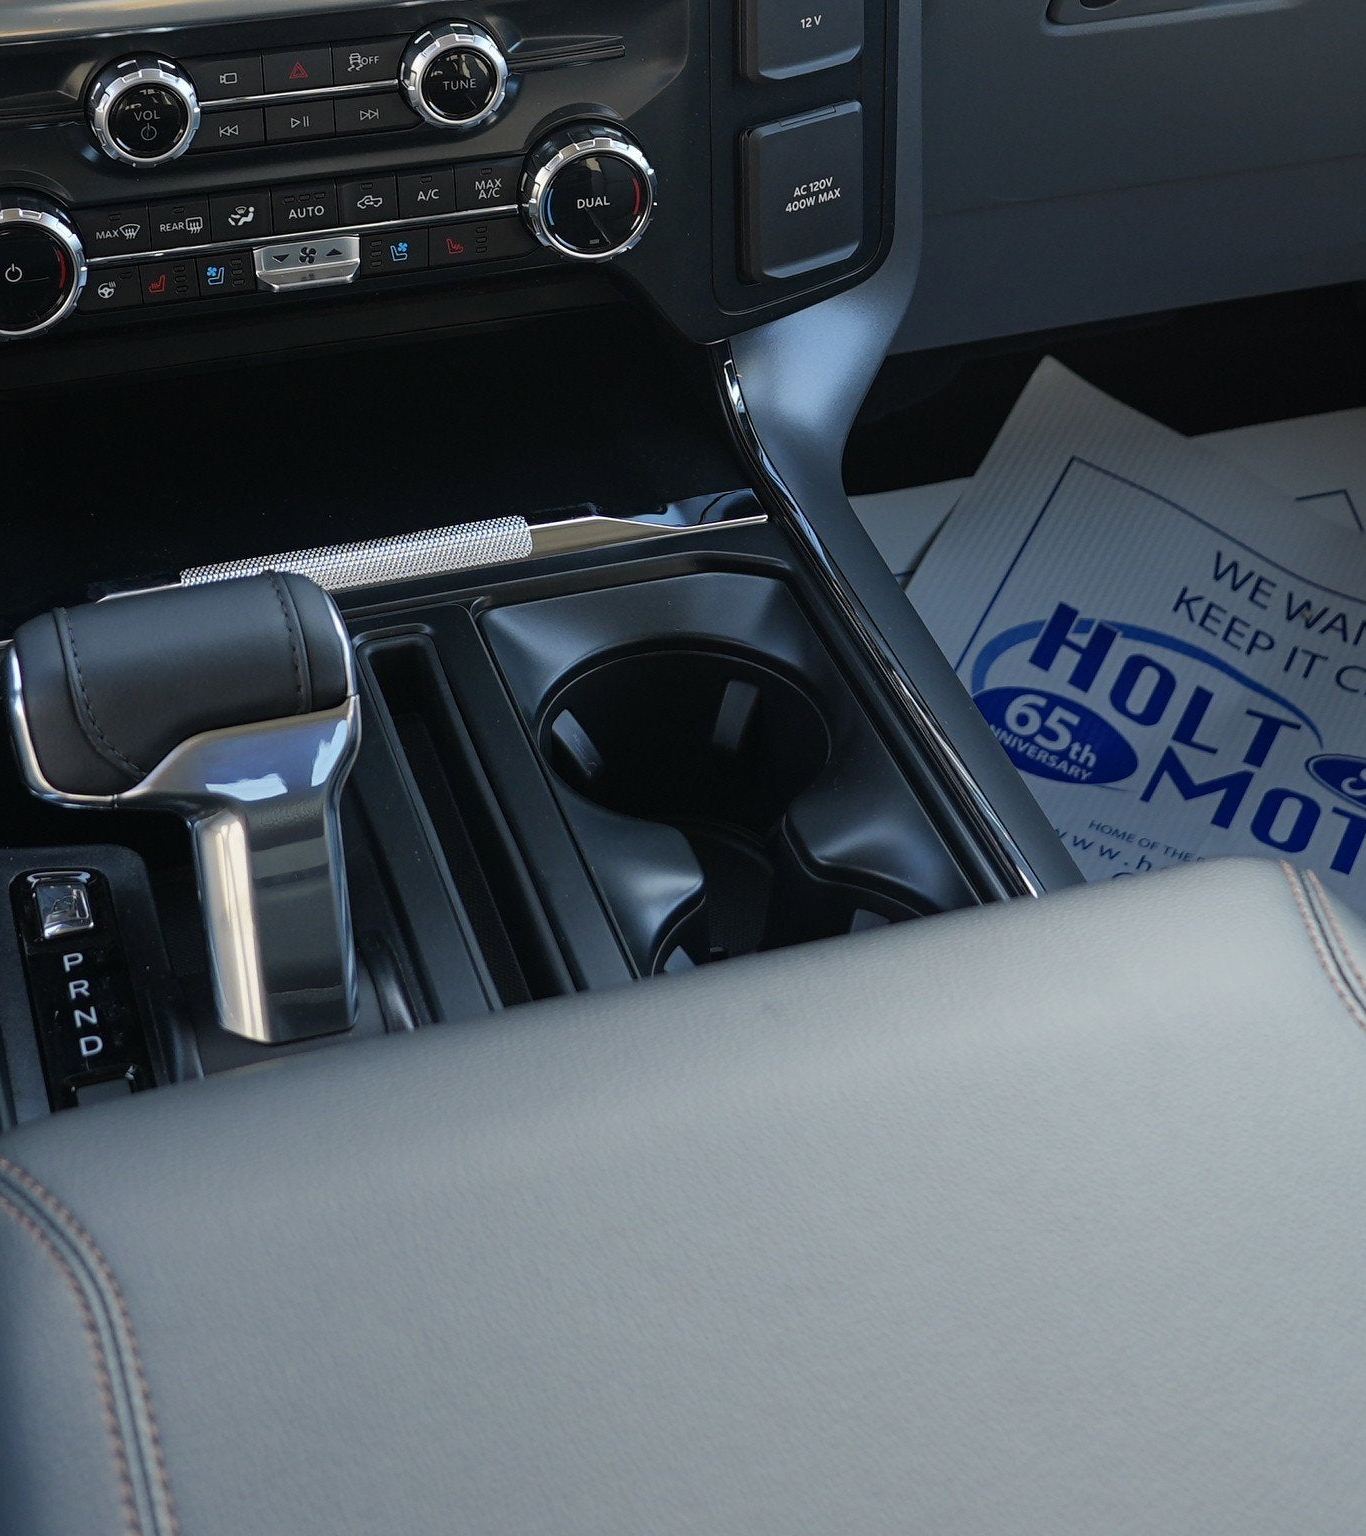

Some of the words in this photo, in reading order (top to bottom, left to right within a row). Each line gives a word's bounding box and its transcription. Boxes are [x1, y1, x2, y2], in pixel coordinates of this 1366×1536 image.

[360, 54, 380, 67] OFF
[441, 78, 477, 92] TUNE
[133, 108, 161, 123] VOL
[474, 178, 502, 191] MAX
[793, 184, 808, 198] AC
[809, 176, 834, 194] 120V
[417, 188, 440, 202] A/C
[478, 187, 501, 200] A/C
[785, 195, 817, 214] 400W
[818, 187, 841, 203] MAX
[576, 195, 611, 210] DUAL
[288, 205, 325, 220] AUTO
[159, 221, 185, 233] REAR
[95, 229, 120, 241] MAX
[1212, 550, 1277, 610] WE
[1171, 586, 1275, 656] KEEP
[1283, 646, 1329, 679] IT
[1028, 602, 1302, 769] HOLT
[1004, 693, 1097, 768] 65th
[1088, 820, 1137, 844] HOME
[1137, 837, 1161, 850] OF
[1162, 845, 1195, 862] THE
